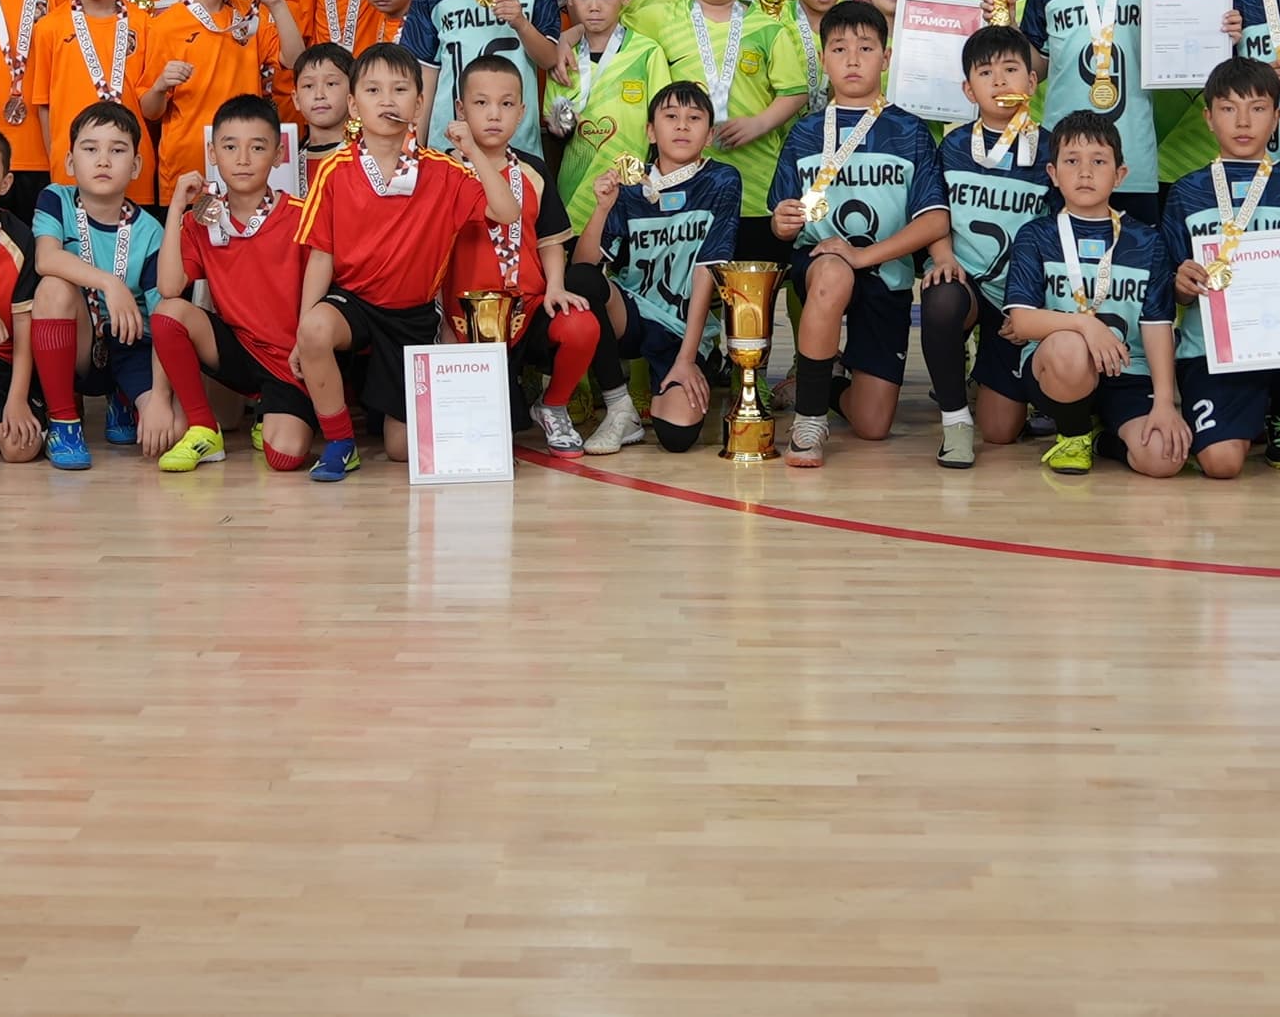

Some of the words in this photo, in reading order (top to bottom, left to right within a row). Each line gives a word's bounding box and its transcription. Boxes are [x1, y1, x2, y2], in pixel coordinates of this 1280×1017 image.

[75, 14, 101, 78] QAZAQSTAN
[691, 12, 715, 75] QAZAQSTAN
[721, 19, 742, 82] QAZAQSTAN
[908, 14, 963, 29] ГРАМОТА
[112, 21, 127, 87] QAZAQSTAN
[799, 23, 818, 88] QAZAQSTAN
[1078, 42, 1126, 121] 9
[436, 364, 490, 375] ДИПЛОМ
[1191, 398, 1217, 433] 2
